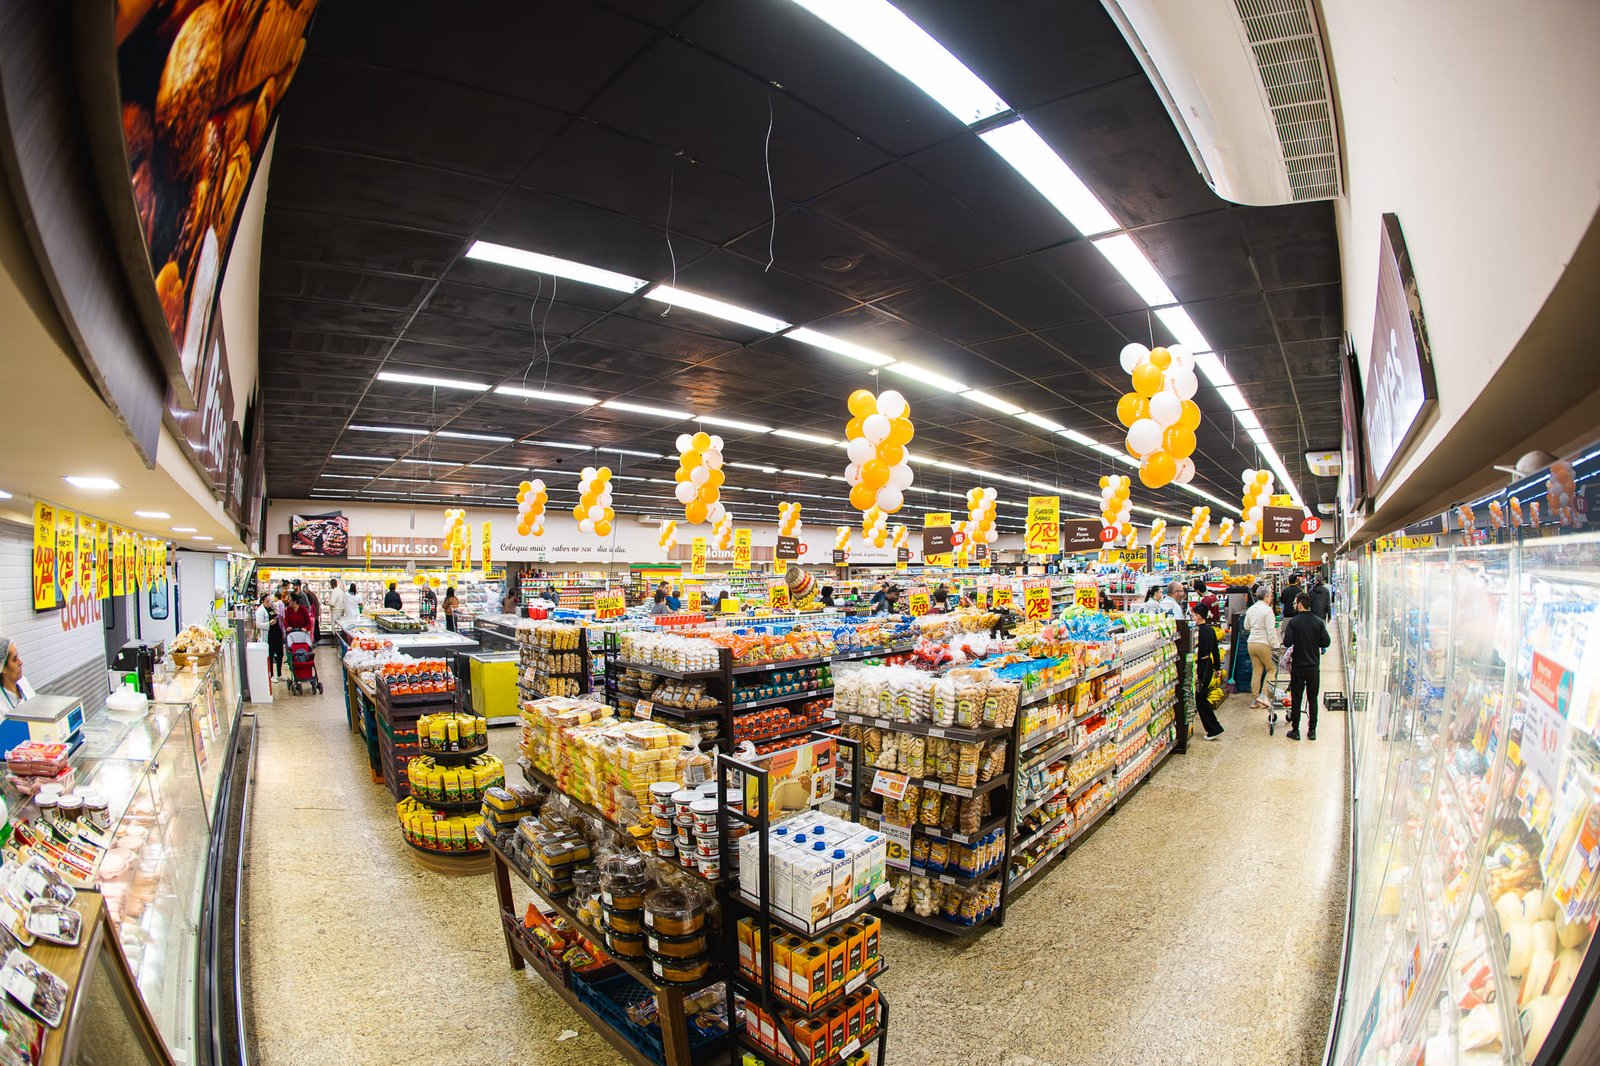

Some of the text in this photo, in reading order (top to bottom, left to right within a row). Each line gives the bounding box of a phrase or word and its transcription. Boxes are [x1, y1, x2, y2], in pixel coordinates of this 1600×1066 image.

[1306, 520, 1318, 531] 18
[954, 533, 963, 543] 16
[1104, 529, 1113, 539] 17
[362, 540, 438, 554] Churrasco
[500, 543, 528, 553] Coloque
[530, 544, 546, 552] mais
[551, 544, 570, 552] sabor
[871, 838, 886, 849] ades
[855, 848, 870, 860] ades
[835, 858, 852, 870] ades
[813, 867, 831, 880] ades
